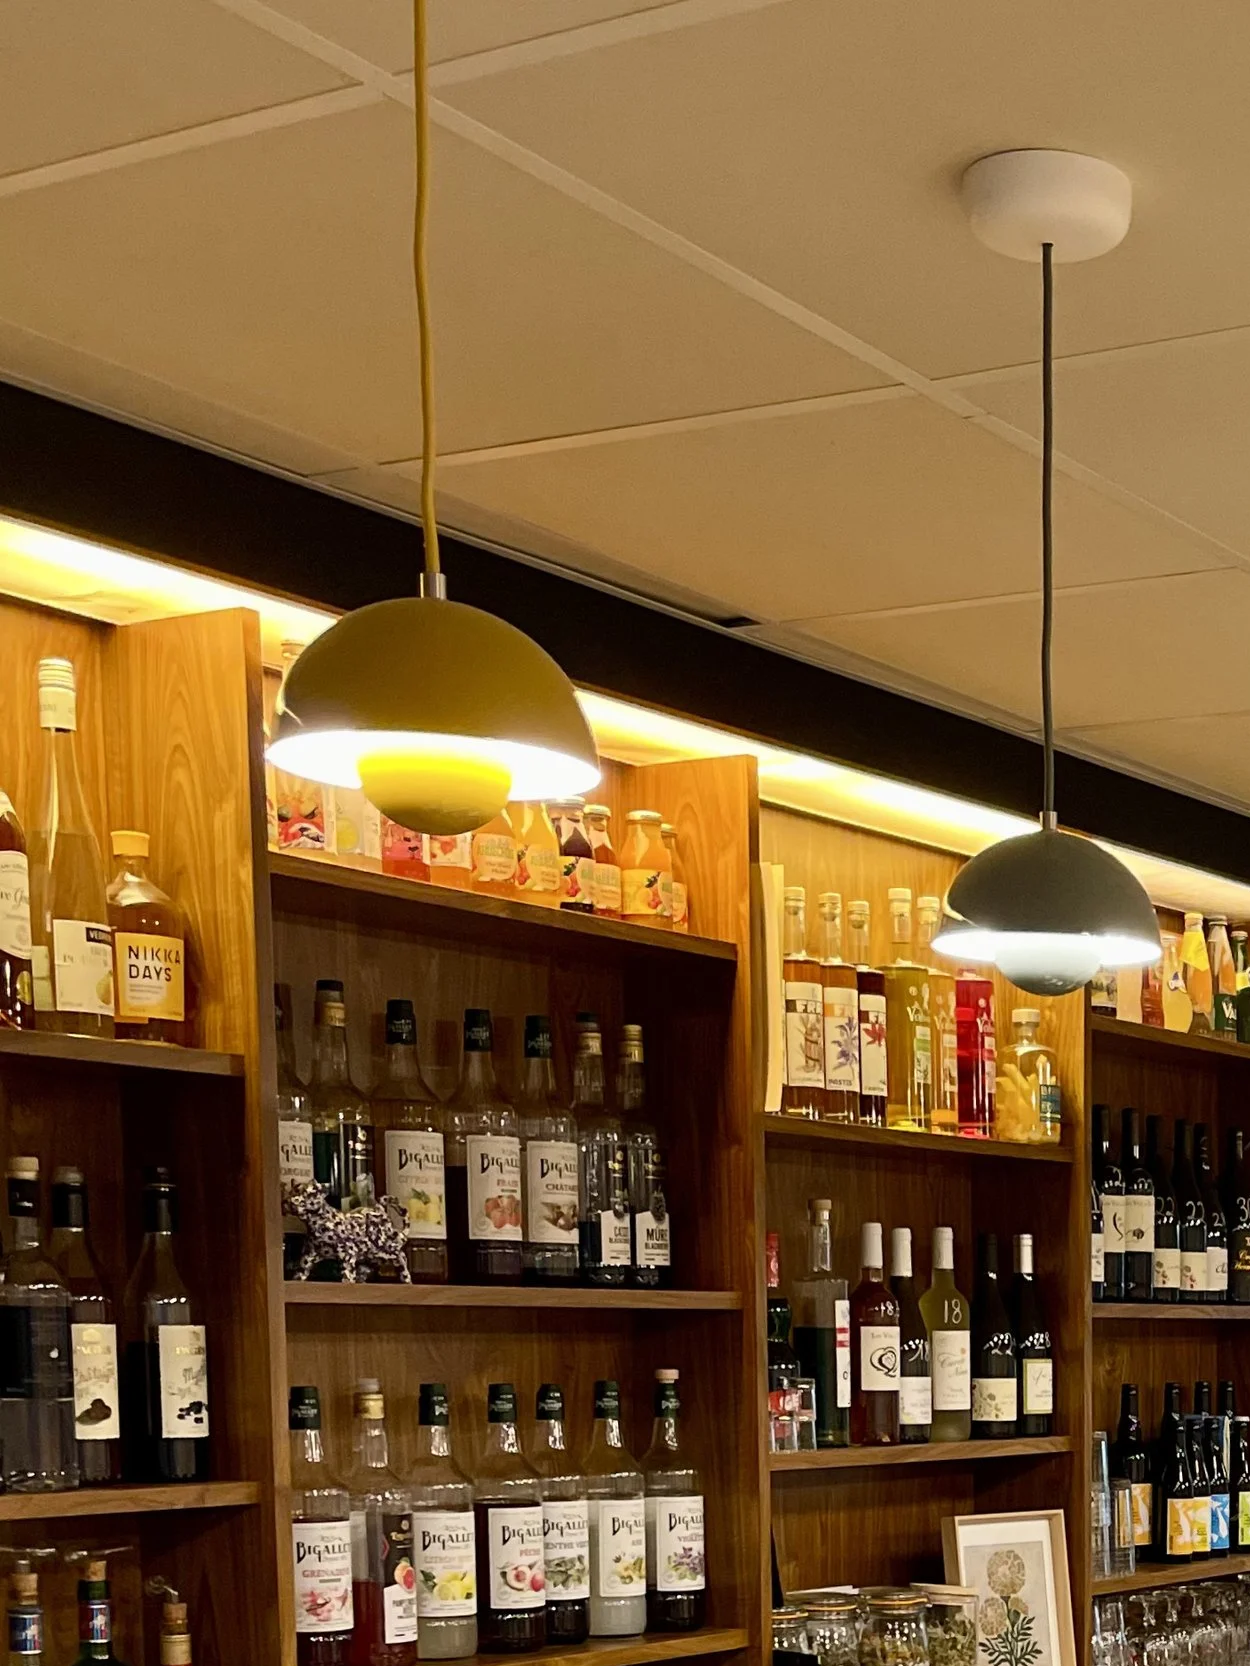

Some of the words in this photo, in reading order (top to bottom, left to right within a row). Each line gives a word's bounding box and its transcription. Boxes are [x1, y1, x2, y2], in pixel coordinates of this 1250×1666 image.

[127, 945, 181, 965] NIKKA
[128, 963, 172, 982] DAYS
[943, 1298, 963, 1325] 18
